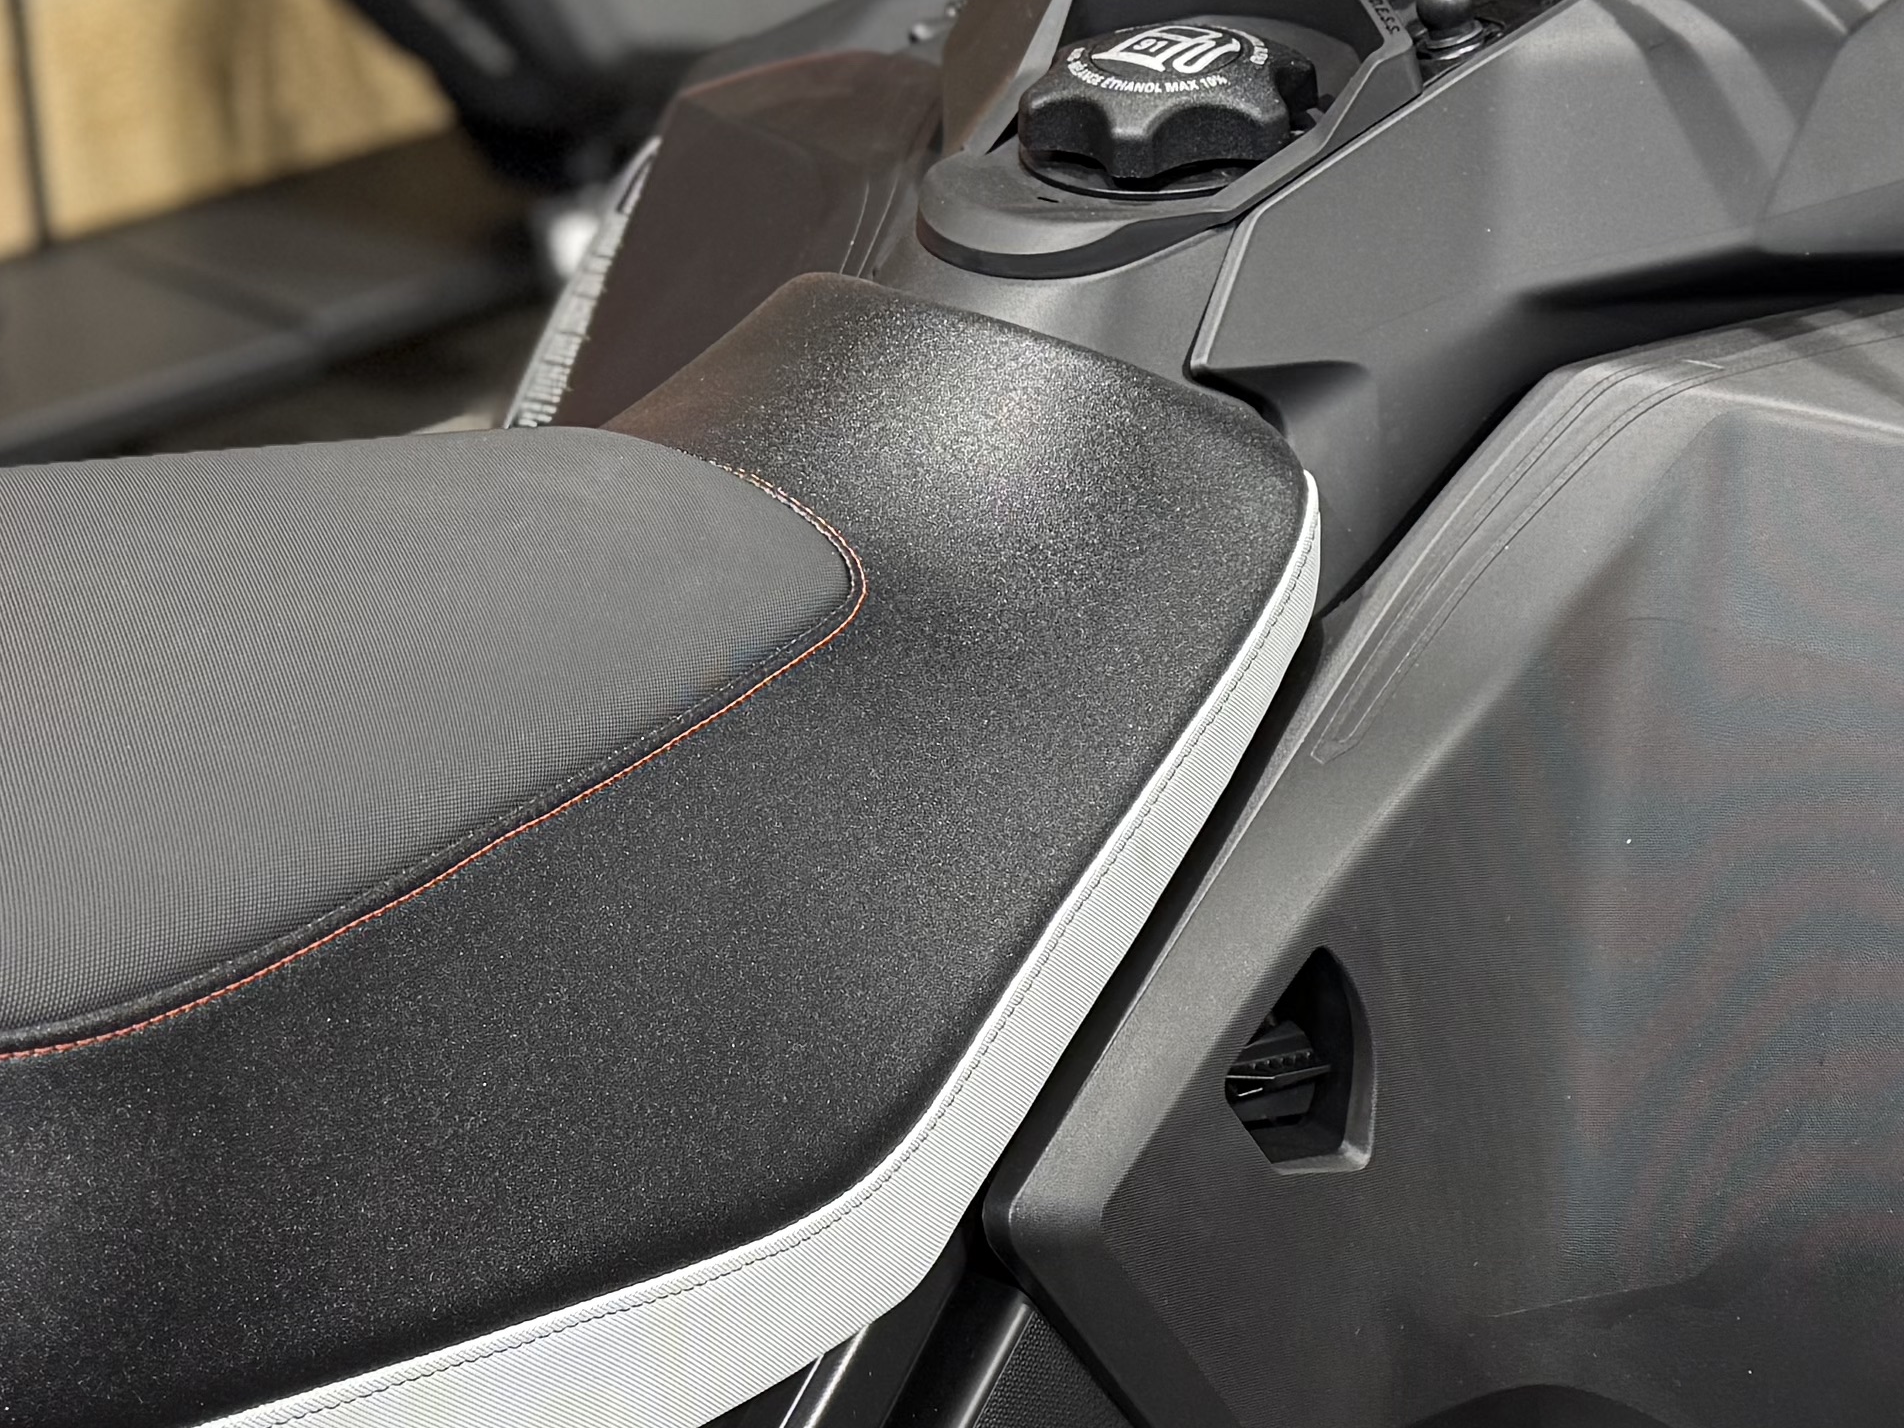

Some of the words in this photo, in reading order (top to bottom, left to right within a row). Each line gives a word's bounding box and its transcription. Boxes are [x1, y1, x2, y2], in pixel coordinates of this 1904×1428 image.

[1132, 38, 1169, 53] 91
[1101, 74, 1163, 93] ÉTHANOL
[1164, 80, 1200, 93] MAX
